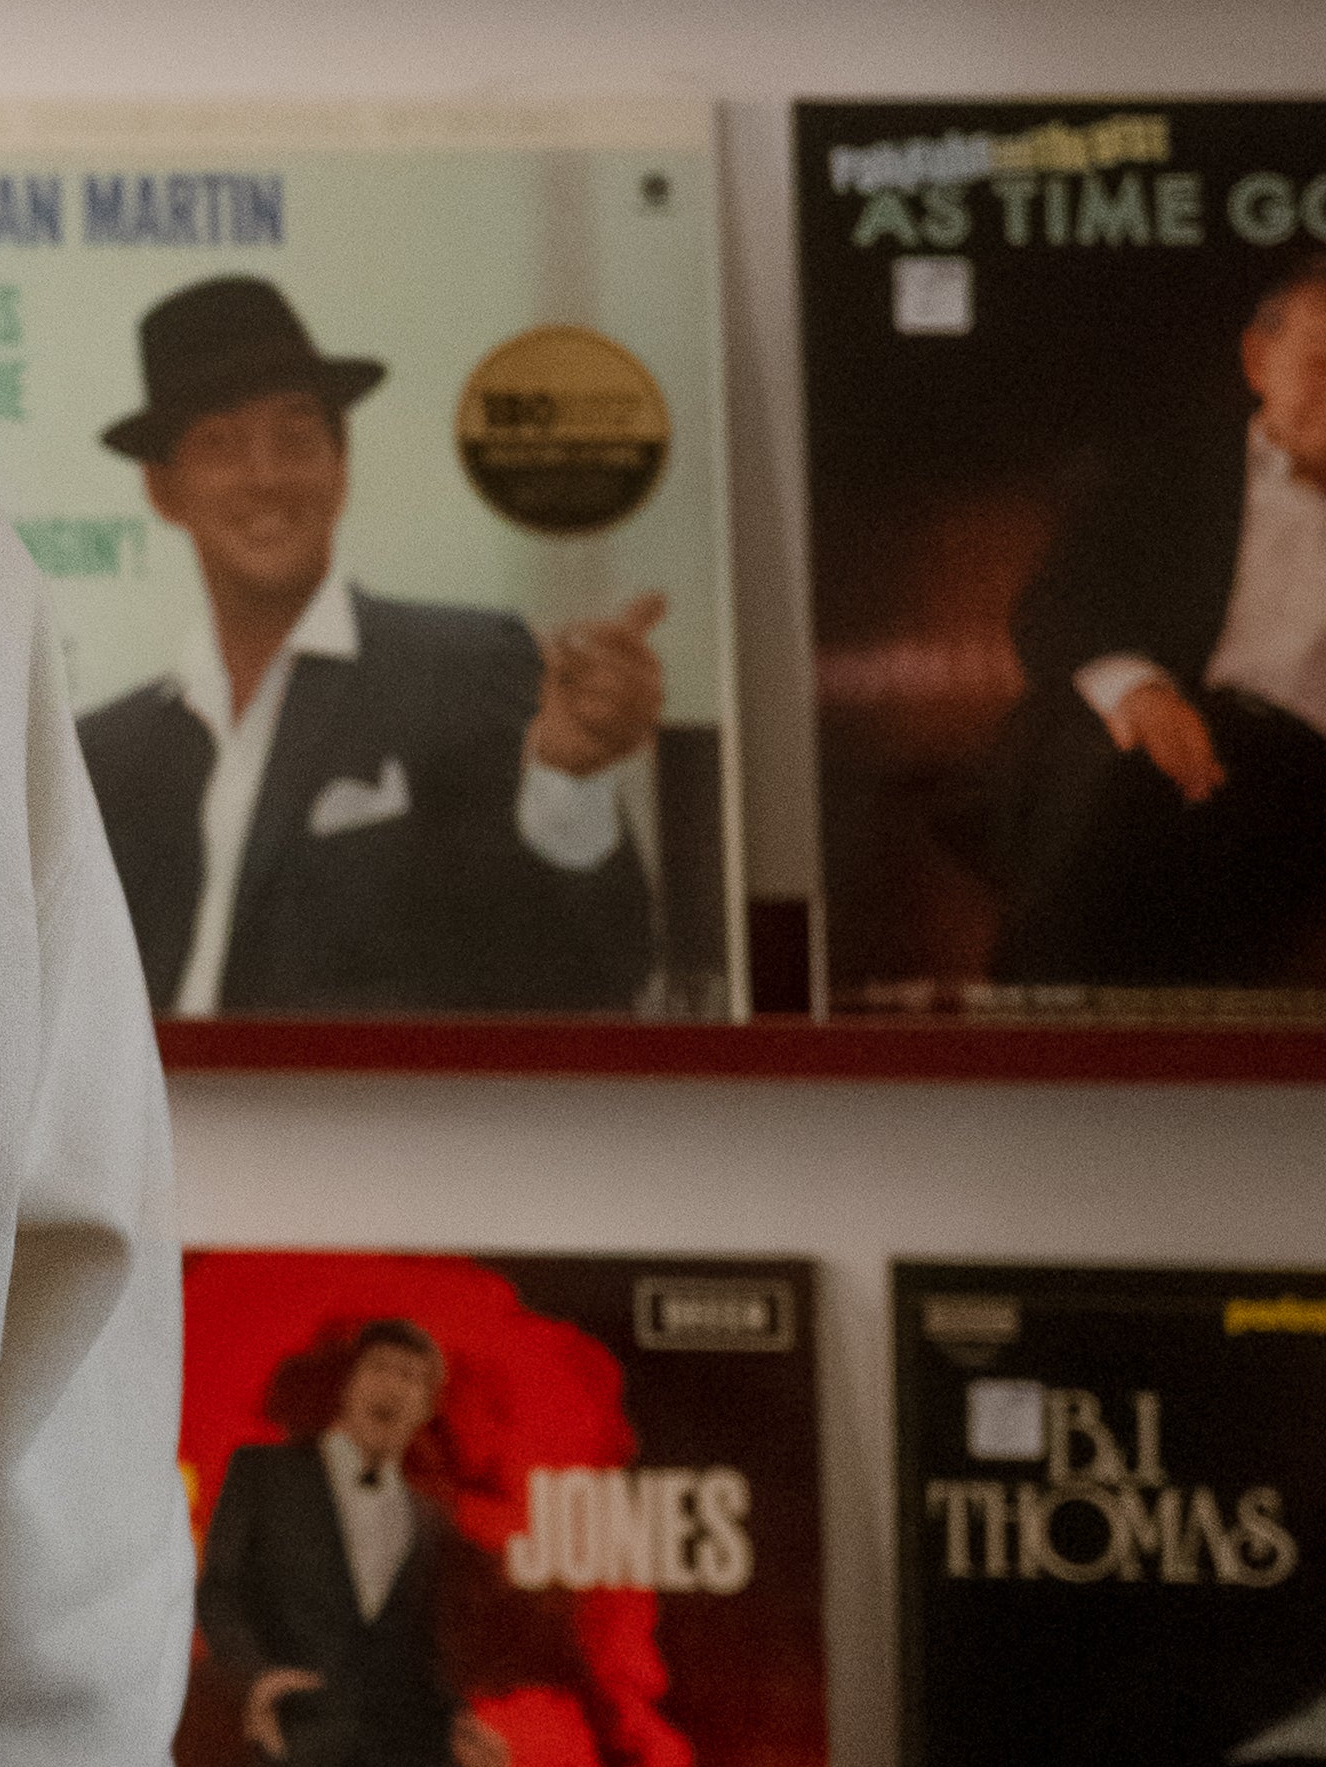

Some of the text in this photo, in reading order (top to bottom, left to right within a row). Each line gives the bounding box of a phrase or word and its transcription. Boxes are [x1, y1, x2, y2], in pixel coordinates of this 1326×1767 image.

[82, 171, 286, 247] MARTIN
[851, 177, 974, 248] AS
[990, 170, 1205, 248] TIME
[506, 1464, 753, 1595] JONES
[924, 1479, 1299, 1589] THOMAS
